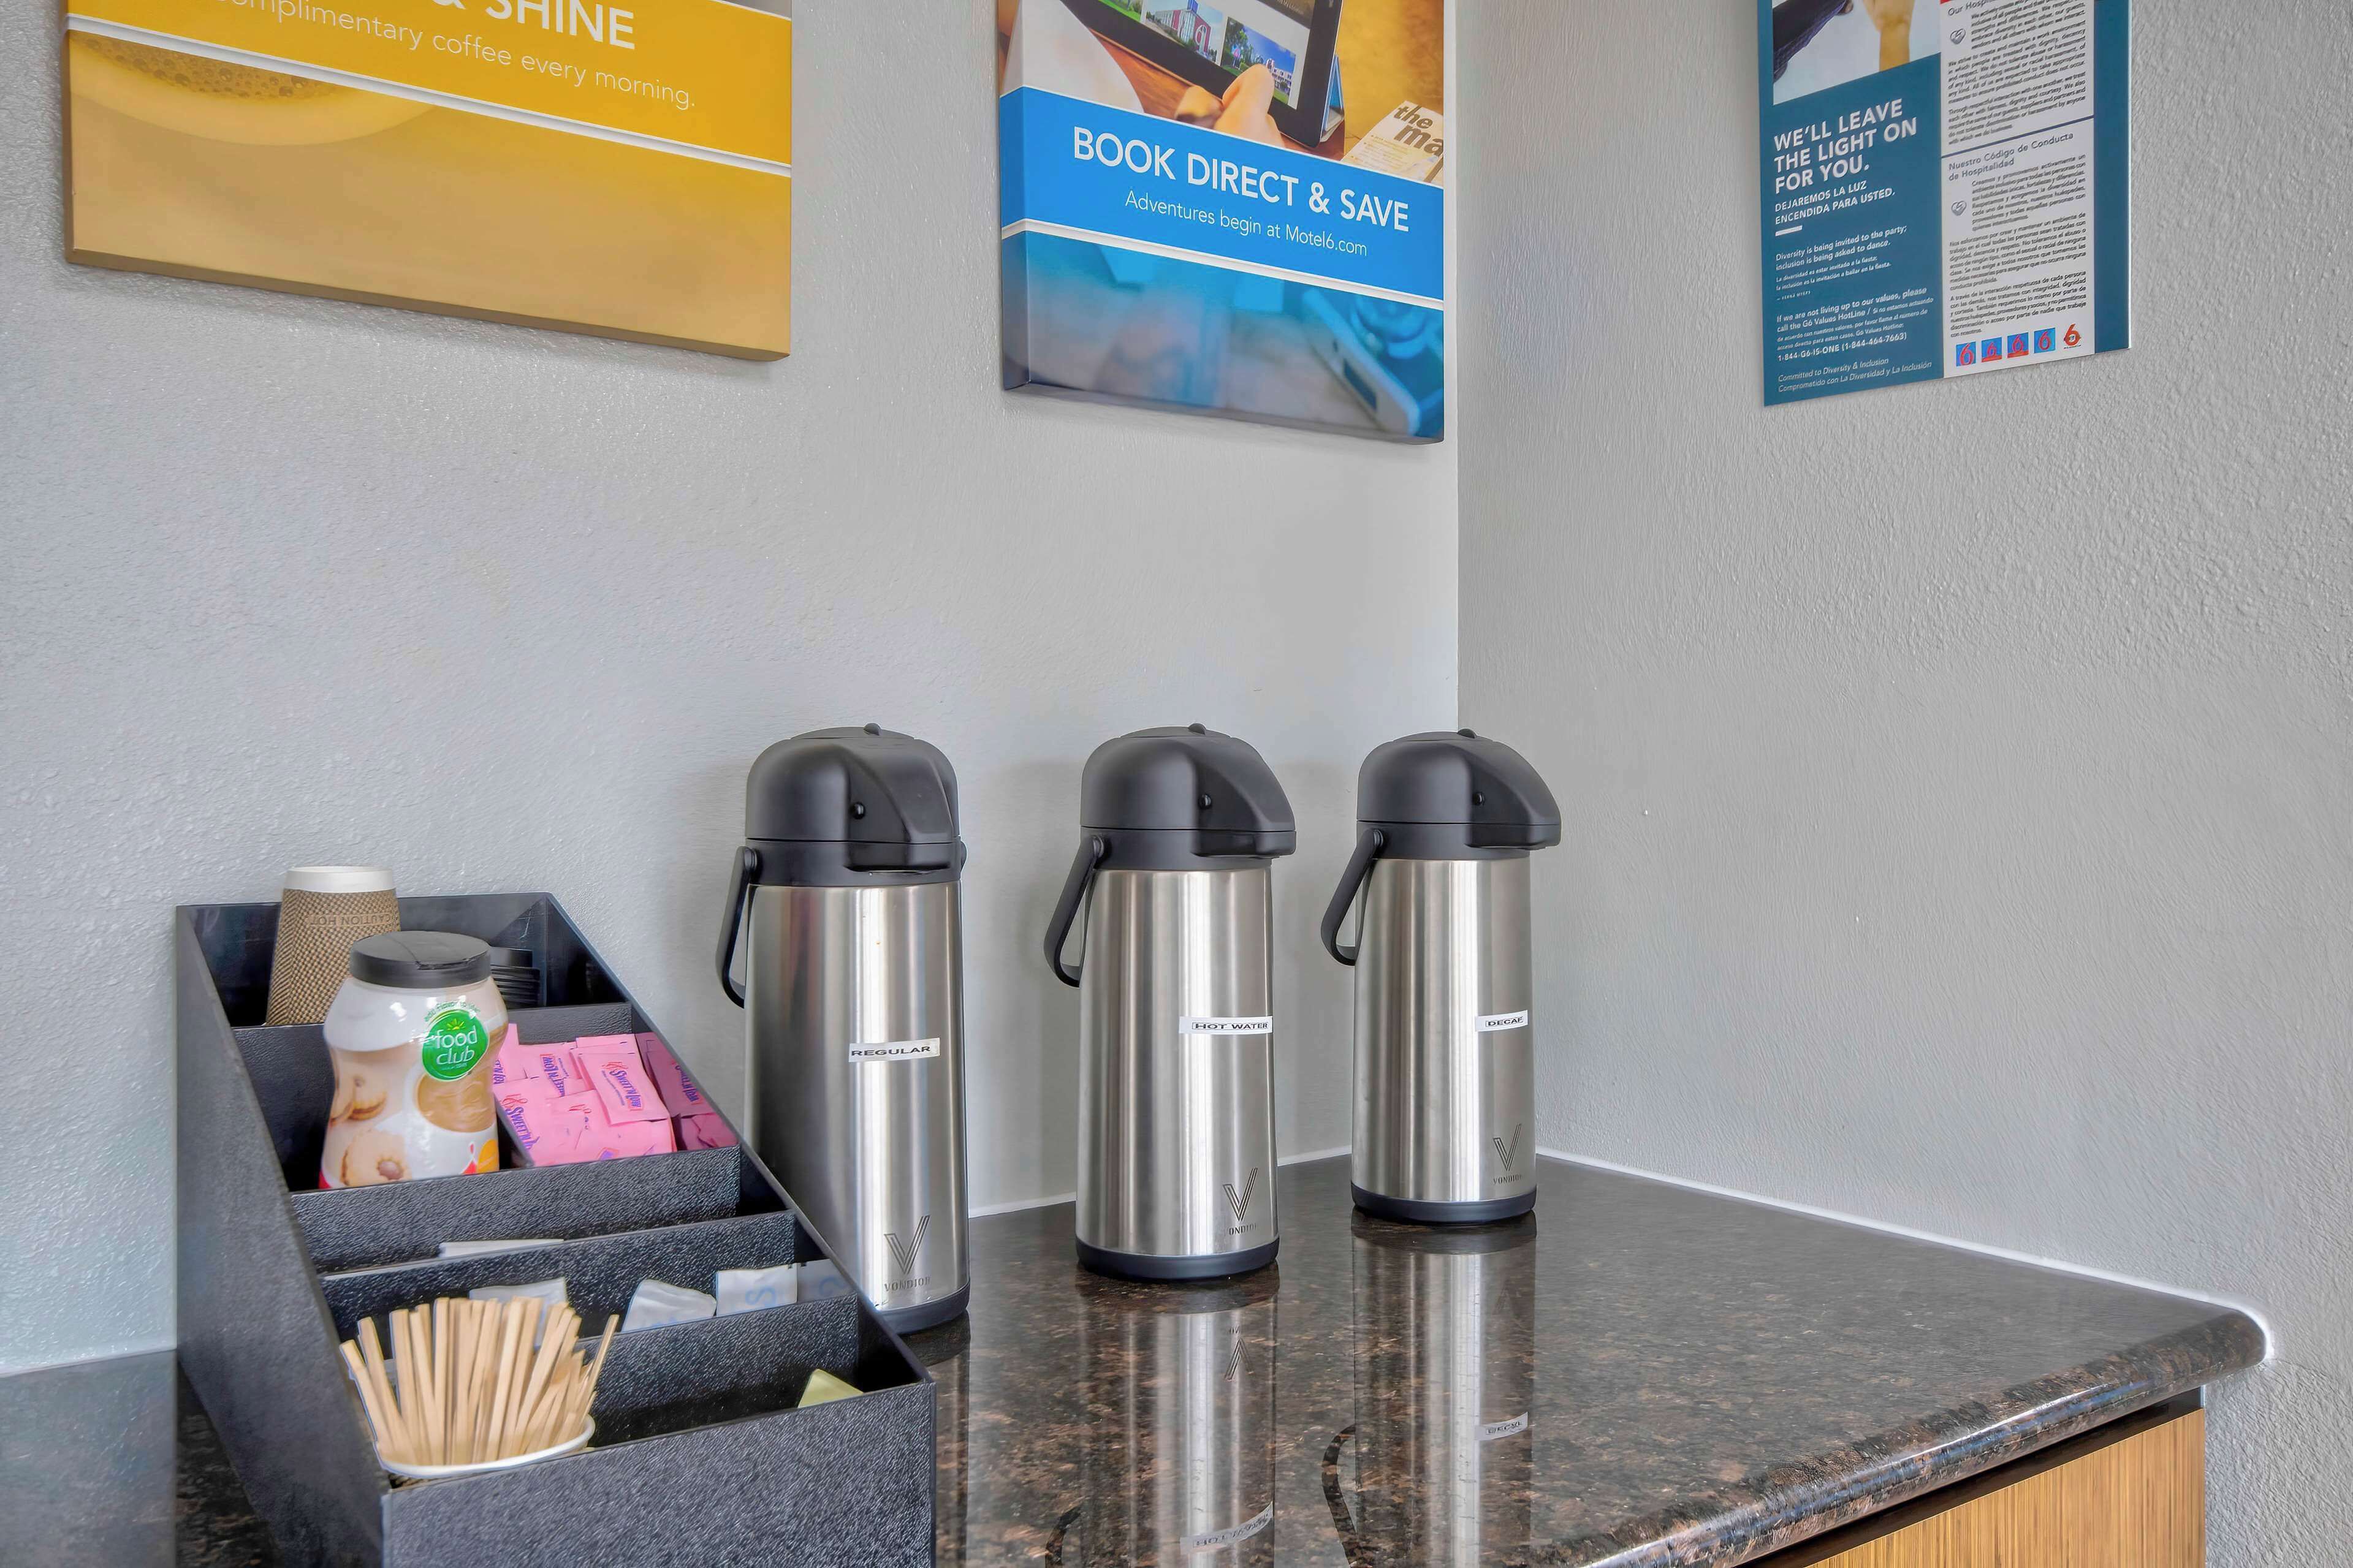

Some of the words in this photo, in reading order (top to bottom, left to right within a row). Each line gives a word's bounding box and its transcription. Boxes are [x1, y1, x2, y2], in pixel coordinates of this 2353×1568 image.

[485, 0, 635, 50] SHINE
[1947, 6, 1963, 16] Our
[216, 0, 423, 50] mplimentary
[433, 34, 512, 65] coffee
[522, 53, 587, 87] every
[595, 70, 696, 111] morning.
[1393, 105, 1433, 129] the
[1774, 121, 1831, 151] WE'LL
[1839, 99, 1902, 133] LEAVE
[1774, 148, 1811, 172] THE
[1818, 129, 1876, 161] LIGHT
[1884, 117, 1916, 142] ON
[1948, 157, 1981, 170] Nuestro
[1983, 148, 2015, 161] Código
[2017, 144, 2028, 153] de
[2031, 133, 2074, 149] Conducta
[1073, 126, 1177, 181] BOOK
[1187, 152, 1299, 206] DIRECT
[1308, 182, 1331, 215] &
[1340, 189, 1410, 233] SAVE
[1776, 169, 1813, 194] FOR
[1819, 154, 1869, 181] YOU.
[1948, 172, 1959, 181] de
[1961, 157, 2014, 177] Hospitalidad
[1775, 190, 1830, 211] DEJAREMOS
[1833, 186, 1846, 197] LA
[1848, 180, 1866, 193] LUZ
[1775, 203, 1830, 224] ENCENDIDA
[1832, 196, 1858, 210] PARA
[1860, 187, 1895, 203] USTED.
[1125, 189, 1215, 225] Adventures
[1220, 209, 1261, 235] begin
[1267, 222, 1281, 239] at
[1285, 224, 1368, 257] Motel6.com
[1776, 249, 1805, 261] Diversity
[1813, 242, 1834, 252] being
[1834, 235, 1860, 247] invited
[1870, 230, 1883, 239] the
[1776, 259, 1804, 270] inclusion
[1813, 252, 1833, 262] being
[1834, 246, 1855, 257] asked
[1806, 308, 1819, 317] not
[1820, 305, 1839, 314] living
[1840, 303, 1850, 311] up
[1902, 287, 1927, 299] please
[1776, 323, 1789, 332] call
[1814, 316, 1836, 325] Values
[1778, 369, 1814, 382] Committed
[1823, 364, 1851, 374] Diversity
[1852, 361, 1858, 369] &
[1859, 358, 1888, 368] Inclusion
[1778, 379, 1825, 392] Comprometido
[1849, 368, 1885, 381] Diversidad
[1885, 368, 1891, 377] y
[1901, 361, 1932, 372] Inclusión
[435, 1025, 477, 1049] food
[1488, 1017, 1523, 1026] DECAF
[436, 1045, 476, 1065] club
[851, 1045, 931, 1056] REGULAR
